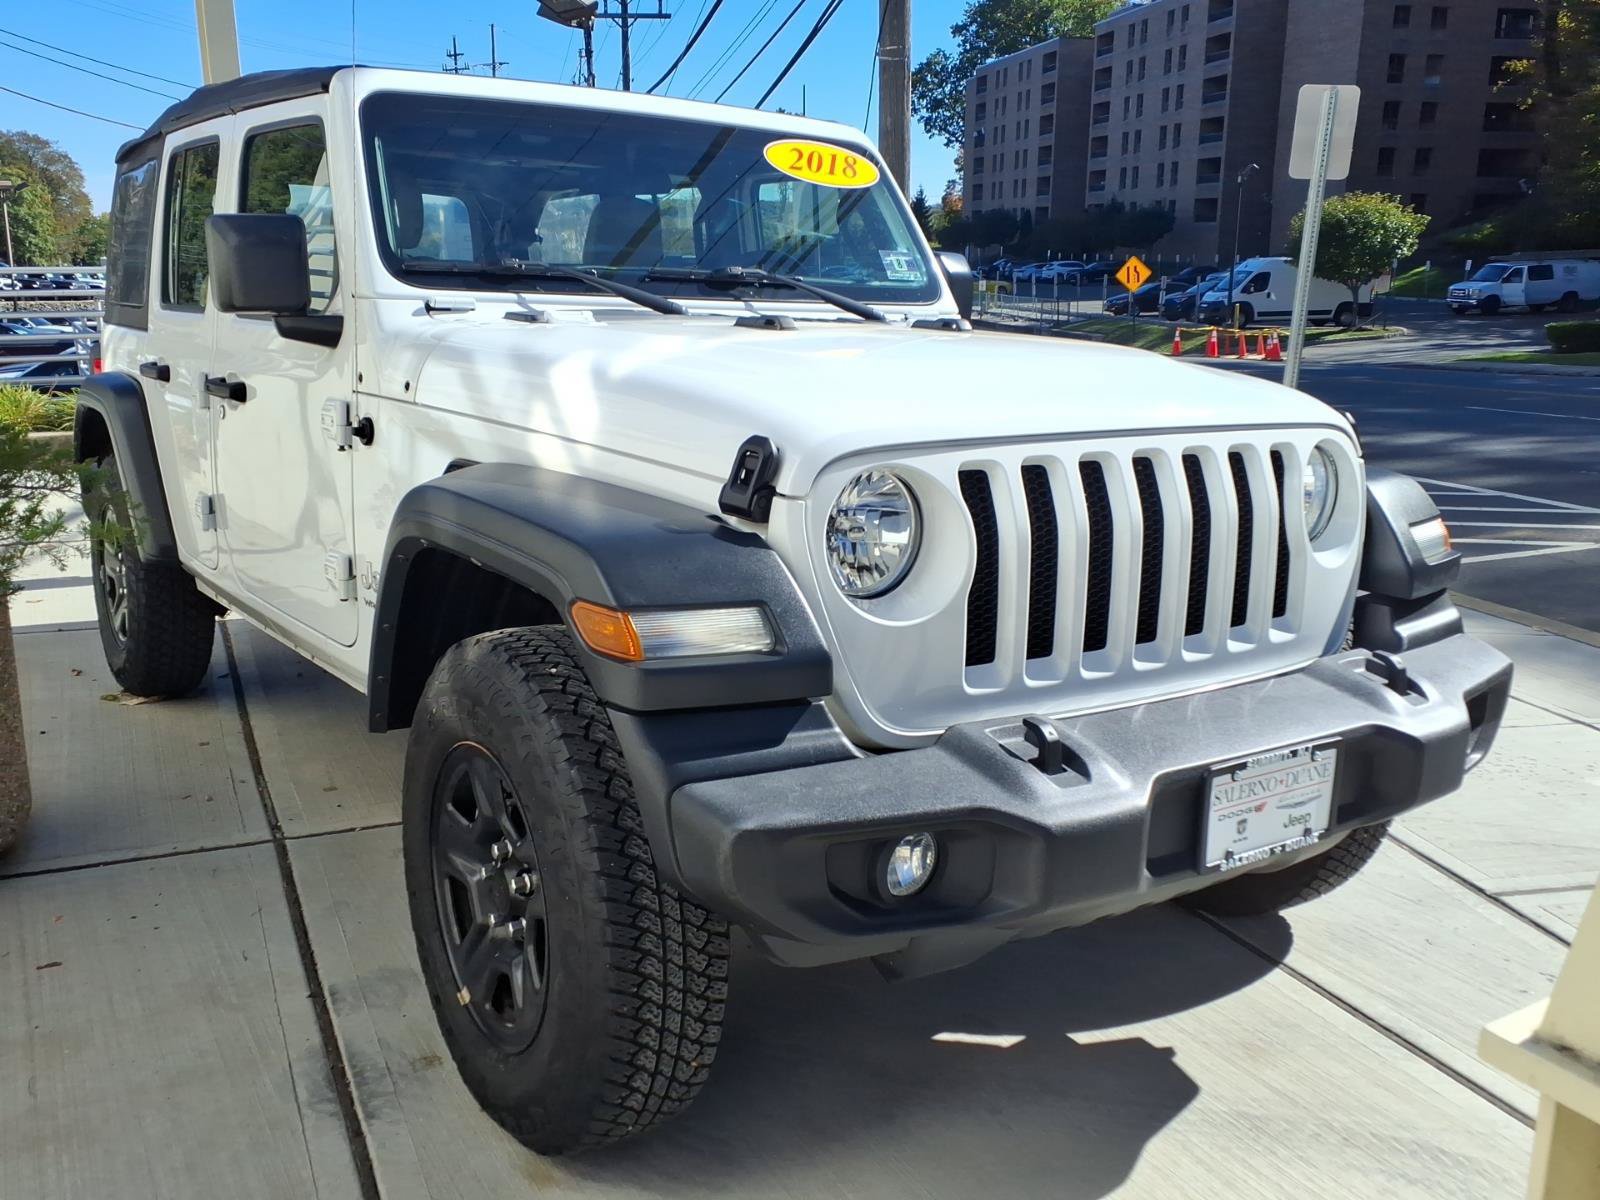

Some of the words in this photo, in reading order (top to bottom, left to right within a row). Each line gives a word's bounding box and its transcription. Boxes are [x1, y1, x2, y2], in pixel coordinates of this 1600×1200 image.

[789, 147, 857, 179] 2018
[1213, 777, 1277, 805] SALERNO
[1285, 762, 1331, 788] DUANE
[1283, 813, 1312, 829] Jeep
[1220, 848, 1271, 872] SALERNO
